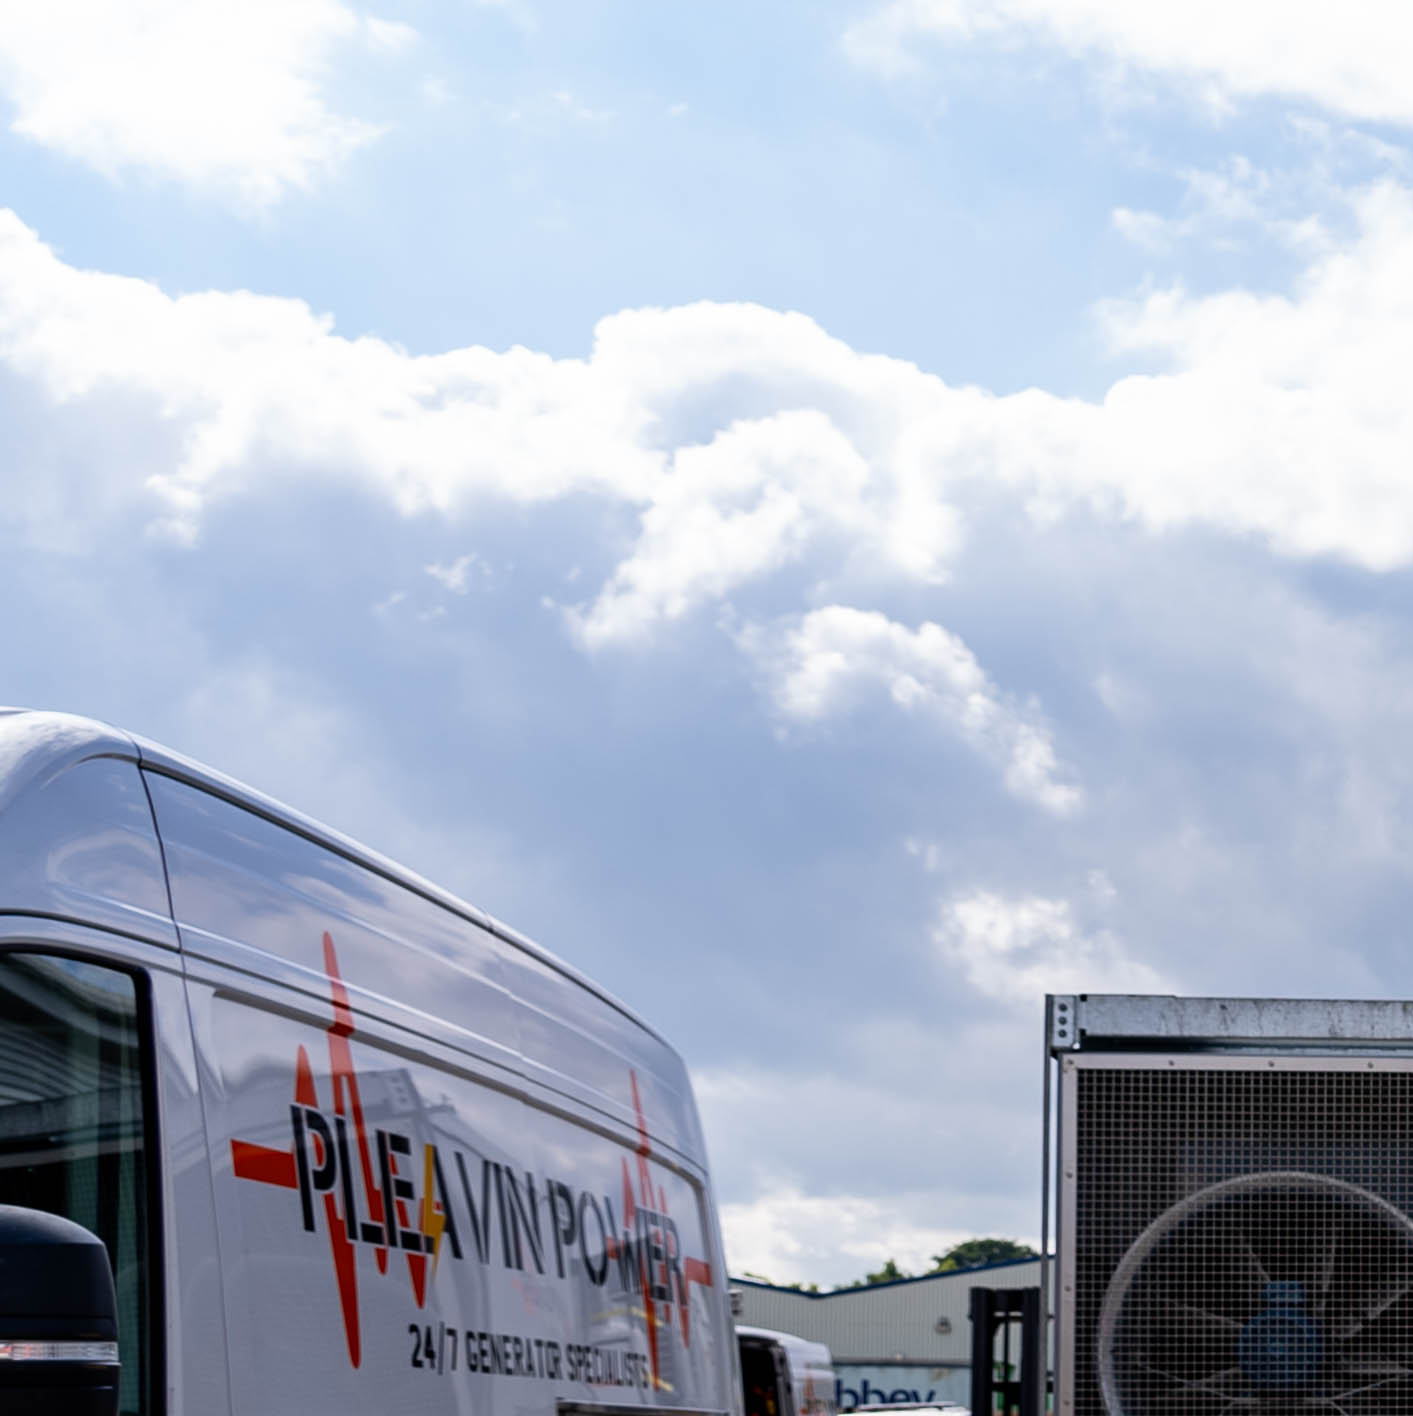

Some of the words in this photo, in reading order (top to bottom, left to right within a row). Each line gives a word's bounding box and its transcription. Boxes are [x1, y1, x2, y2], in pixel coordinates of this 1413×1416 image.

[290, 1103, 546, 1275] PLEAVIN
[546, 1177, 688, 1307] POWER
[408, 1321, 458, 1375] 24/7
[465, 1331, 563, 1380] GENERATOR
[567, 1342, 650, 1389] SPECIALISTS
